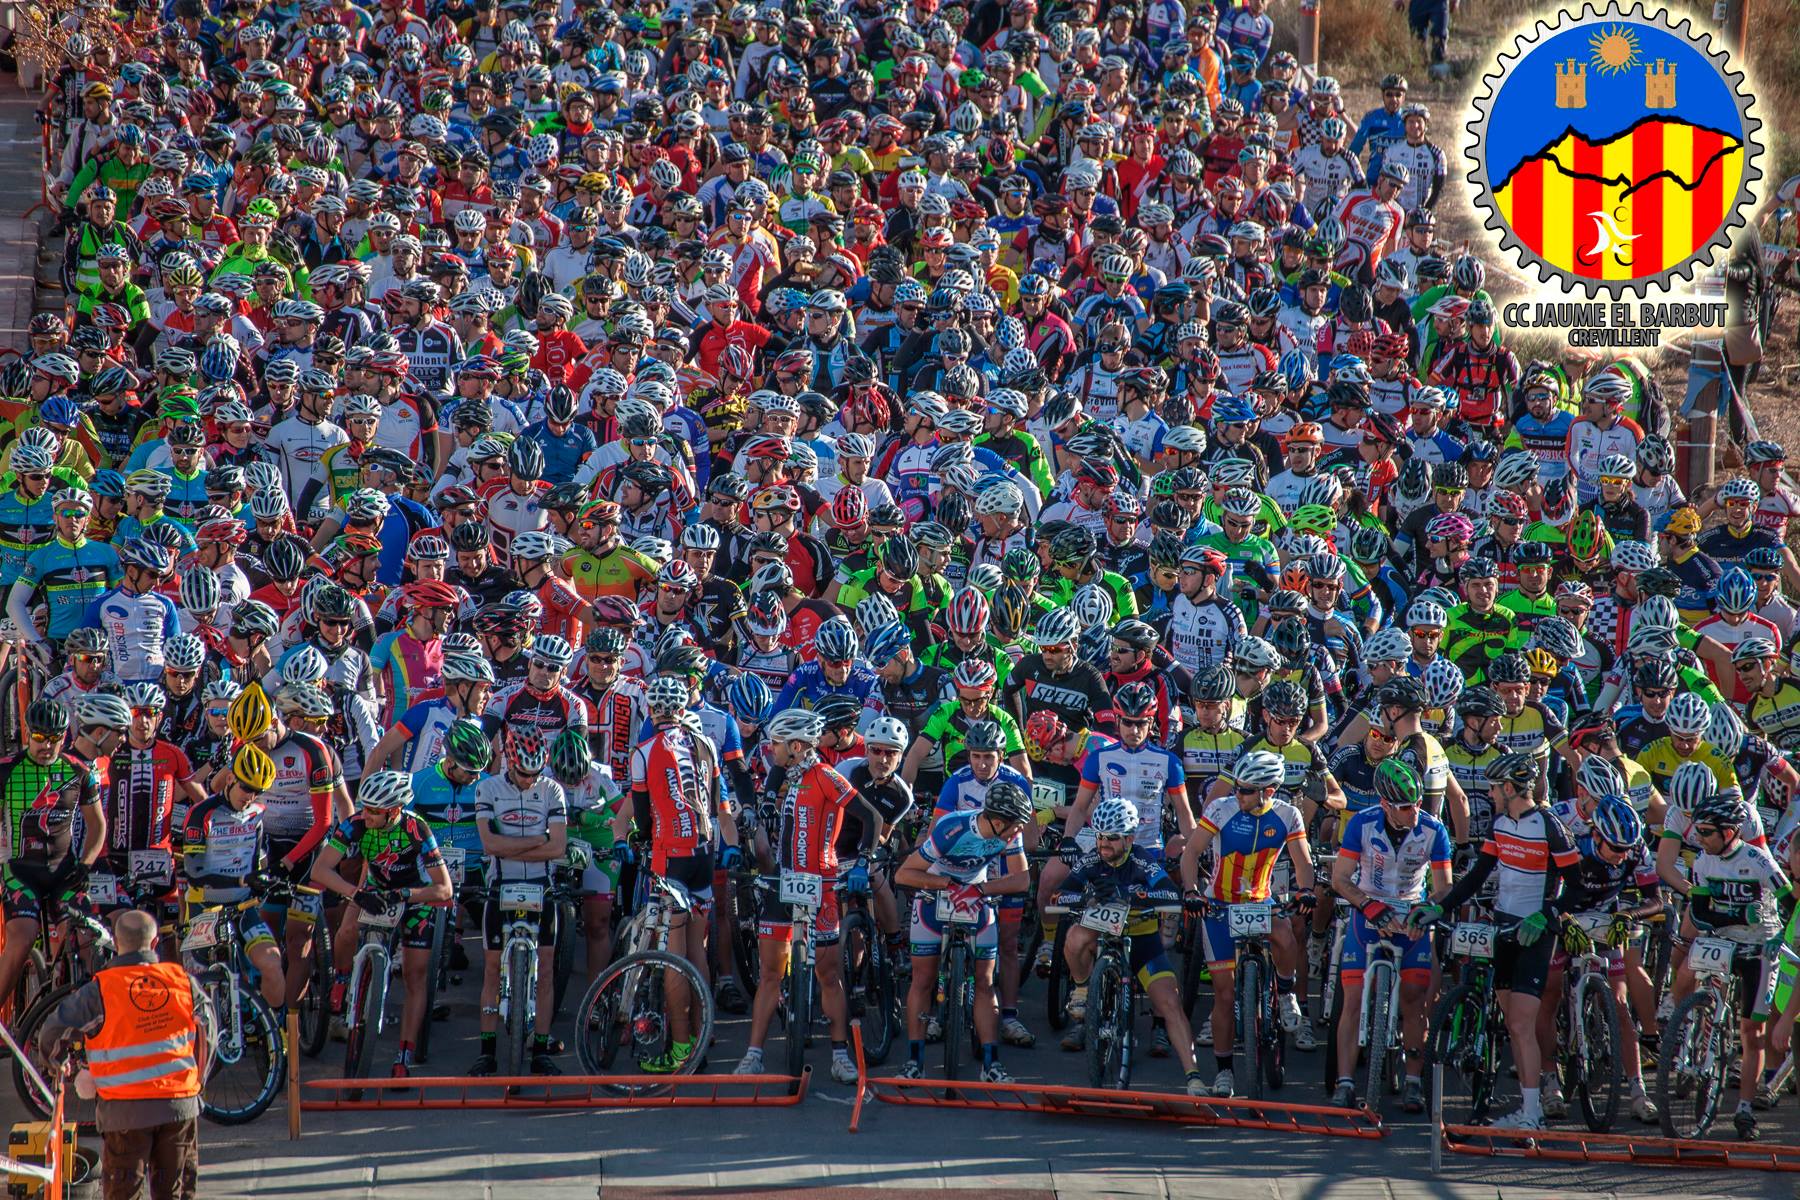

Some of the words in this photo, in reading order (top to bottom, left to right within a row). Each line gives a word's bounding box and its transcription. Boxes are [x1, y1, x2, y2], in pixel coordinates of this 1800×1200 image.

[1034, 786, 1059, 802] 171
[118, 779, 128, 849] GOBIK
[798, 805, 808, 831] BIKE
[229, 826, 247, 834] BIKE
[678, 811, 692, 838] BIKE
[796, 831, 808, 869] MUNDO
[135, 860, 166, 874] 247
[786, 882, 817, 896] 102
[517, 894, 526, 903] 3
[1089, 908, 1121, 925] 203
[1458, 930, 1489, 946] 365
[1702, 947, 1721, 961] 70
